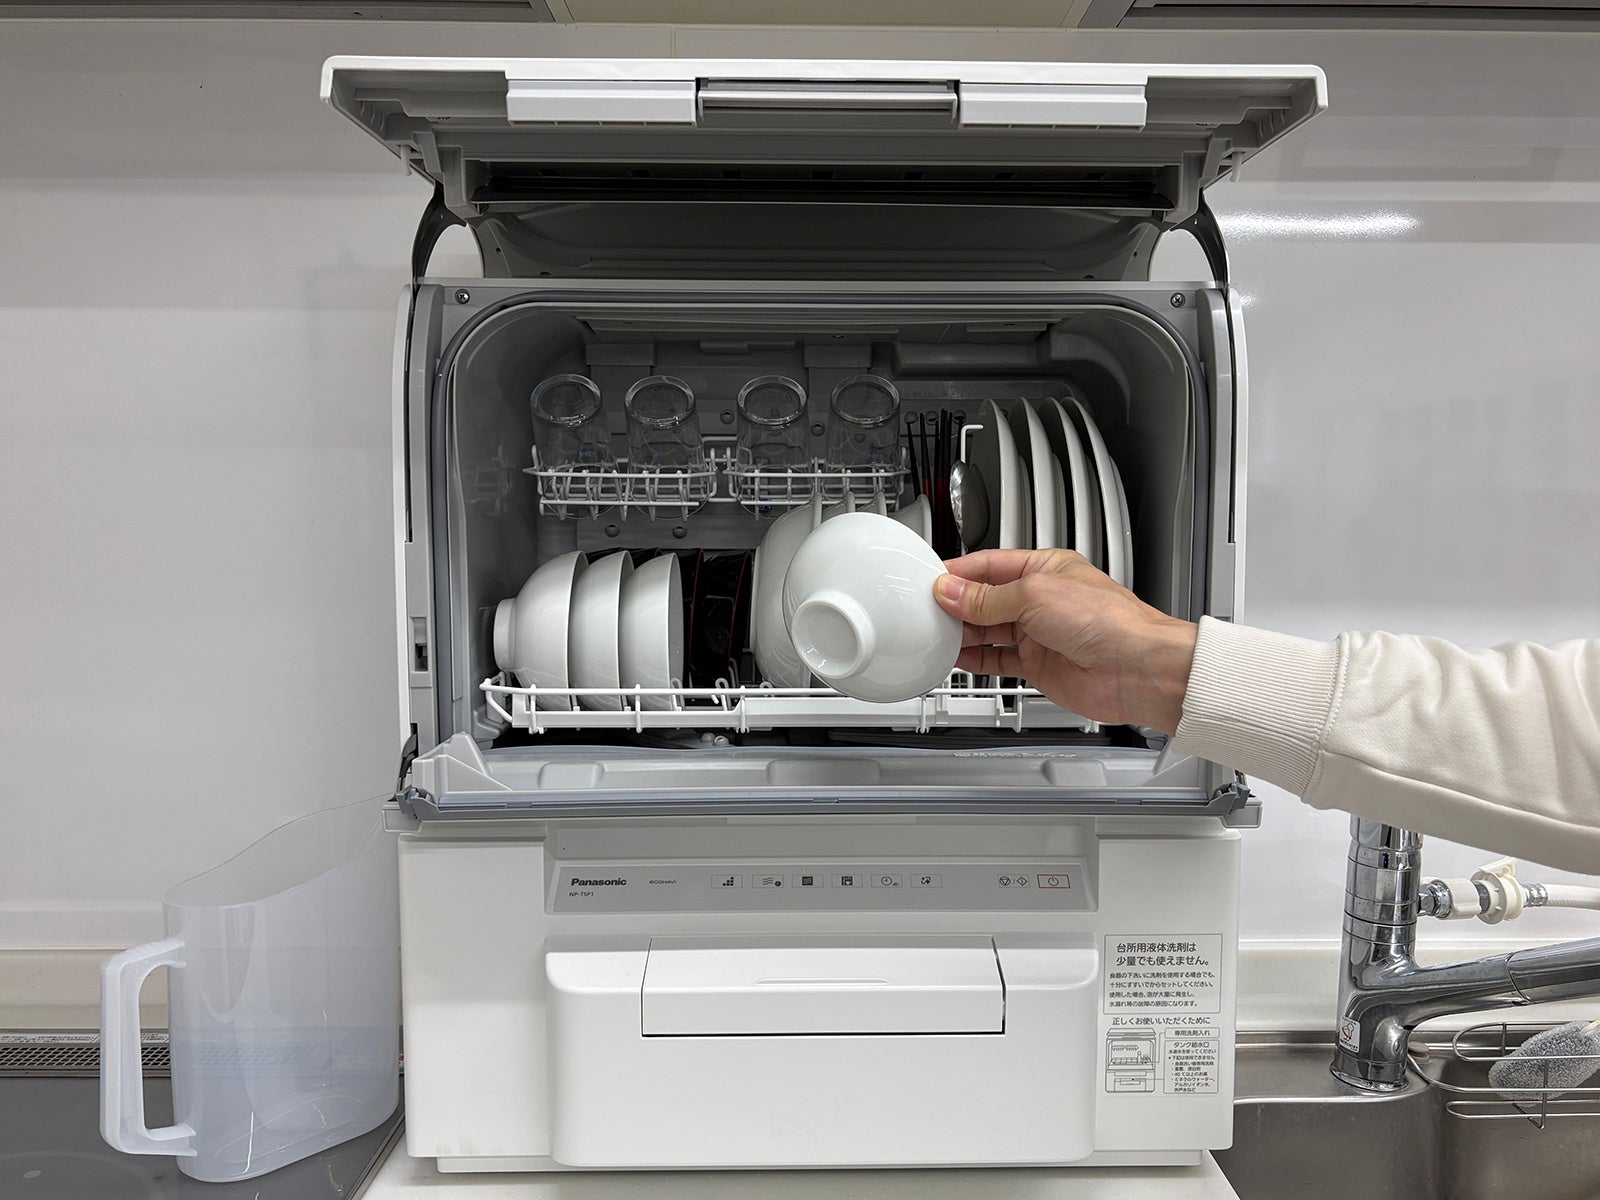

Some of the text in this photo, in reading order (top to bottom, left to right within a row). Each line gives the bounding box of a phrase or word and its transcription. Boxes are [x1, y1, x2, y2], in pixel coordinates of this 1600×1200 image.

[571, 877, 627, 886] Panasonic
[1116, 942, 1196, 953] 台所用液体洗剤は
[1116, 956, 1209, 966] 少量でも使えません。
[1112, 1017, 1211, 1025] 正しくお使いいただくために
